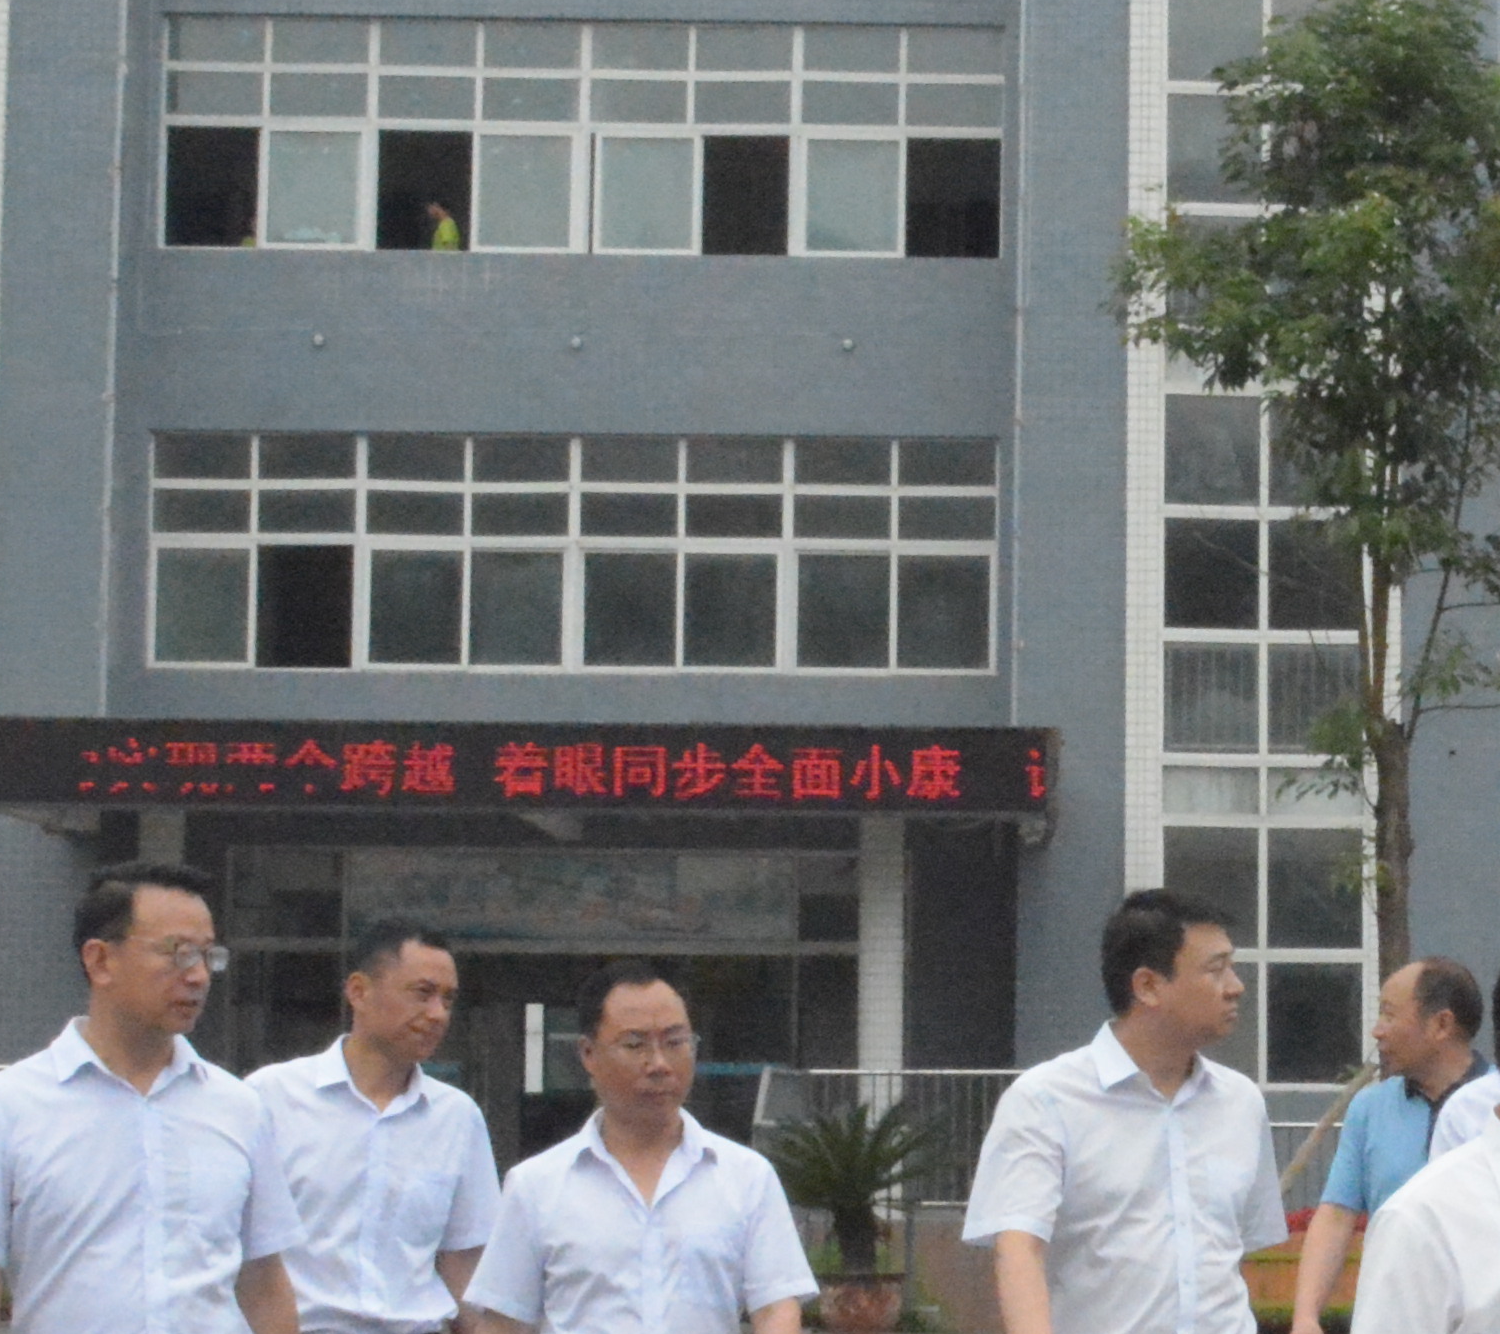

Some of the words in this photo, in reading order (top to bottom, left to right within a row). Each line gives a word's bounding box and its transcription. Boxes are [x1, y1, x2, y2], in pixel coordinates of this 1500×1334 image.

[493, 741, 962, 801] 着眼同步全面小康
